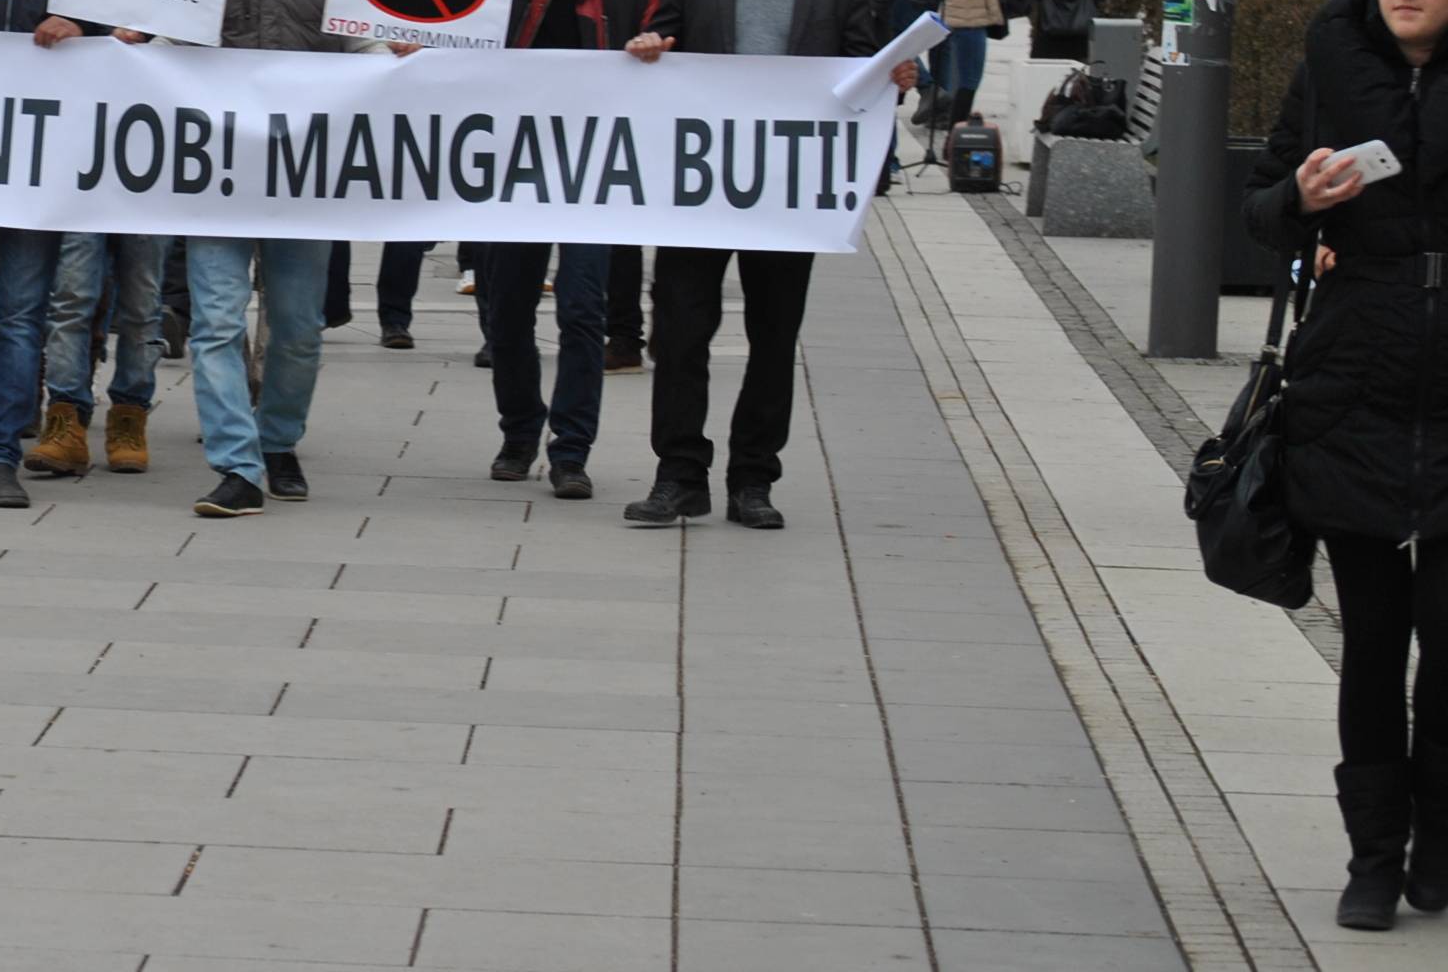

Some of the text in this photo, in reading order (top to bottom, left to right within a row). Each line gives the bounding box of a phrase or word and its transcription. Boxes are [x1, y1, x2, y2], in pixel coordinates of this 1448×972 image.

[328, 17, 370, 36] STOP
[77, 100, 236, 198] JOB!
[265, 111, 646, 207] MANGAVA
[671, 117, 859, 212] BUTI!
